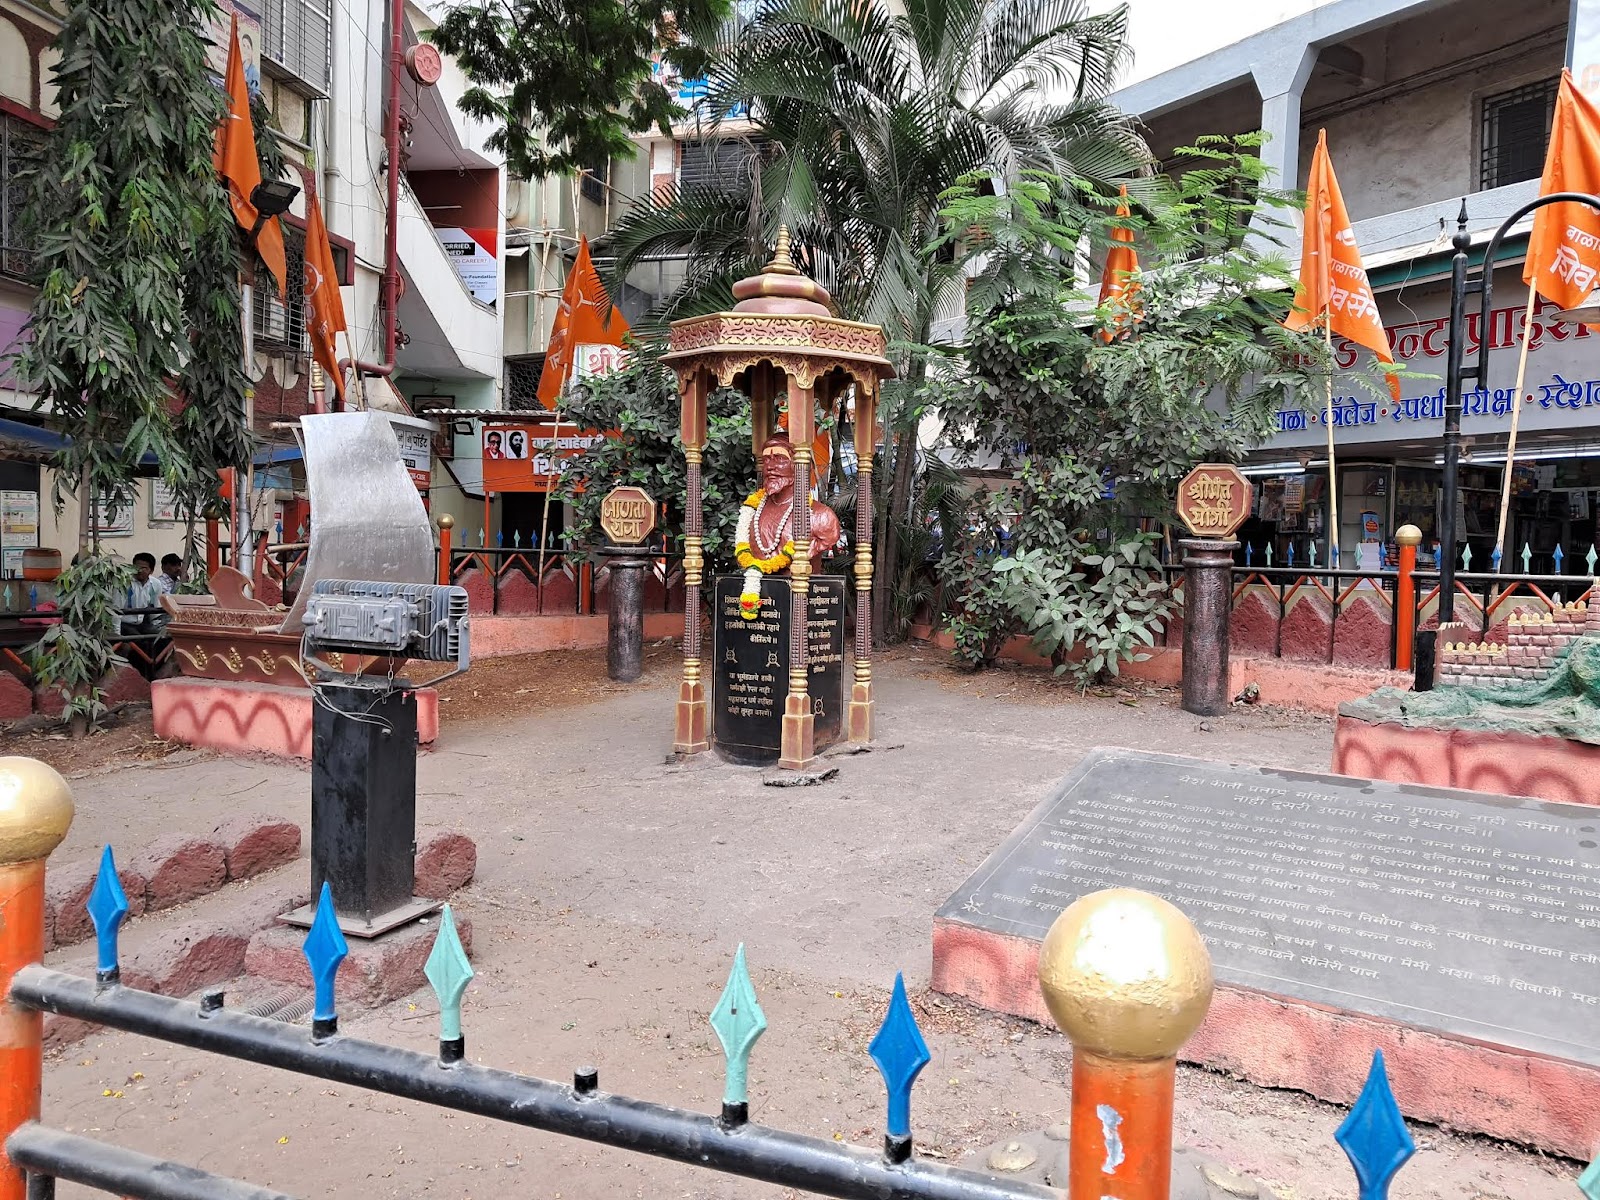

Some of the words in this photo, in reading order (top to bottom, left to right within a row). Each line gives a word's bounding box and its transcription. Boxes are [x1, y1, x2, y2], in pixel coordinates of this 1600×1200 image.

[1549, 244, 1600, 293] शिव
[1320, 395, 1378, 427] कॉलेज
[1187, 473, 1235, 500] श्रीमंत
[1233, 794, 1267, 806] नाही
[1271, 801, 1310, 812] दुसरी
[1316, 806, 1357, 818] उपमा
[1408, 814, 1476, 835] ईश्वराचे
[1262, 839, 1307, 852] अभिषेक
[1495, 874, 1533, 888] घेतली
[1421, 839, 1454, 850] जन्म
[1507, 852, 1542, 862] वचन
[1422, 851, 1491, 868] इतिहासात
[1497, 863, 1519, 872] एक
[1271, 852, 1345, 871] दिलदारपणाने
[1349, 866, 1370, 875] सर्व
[1431, 879, 1456, 889] सर्व
[1487, 903, 1523, 914] अनेक
[1222, 889, 1256, 901] मराठी
[1259, 896, 1310, 911] माणसात
[1315, 905, 1352, 919] चैतन्य
[1357, 912, 1403, 928] निर्माण
[1502, 939, 1562, 958] मनगटात
[1569, 951, 1600, 971] हत्ती
[1292, 917, 1323, 929] पाणी
[1327, 923, 1351, 934] लाल
[1223, 940, 1243, 950] एक
[1300, 955, 1343, 971] सोनेरी
[1400, 958, 1430, 971] प्रेमी
[1438, 965, 1473, 979] अशा
[1483, 975, 1501, 985] श्री
[1509, 979, 1562, 997] शिवाजी
